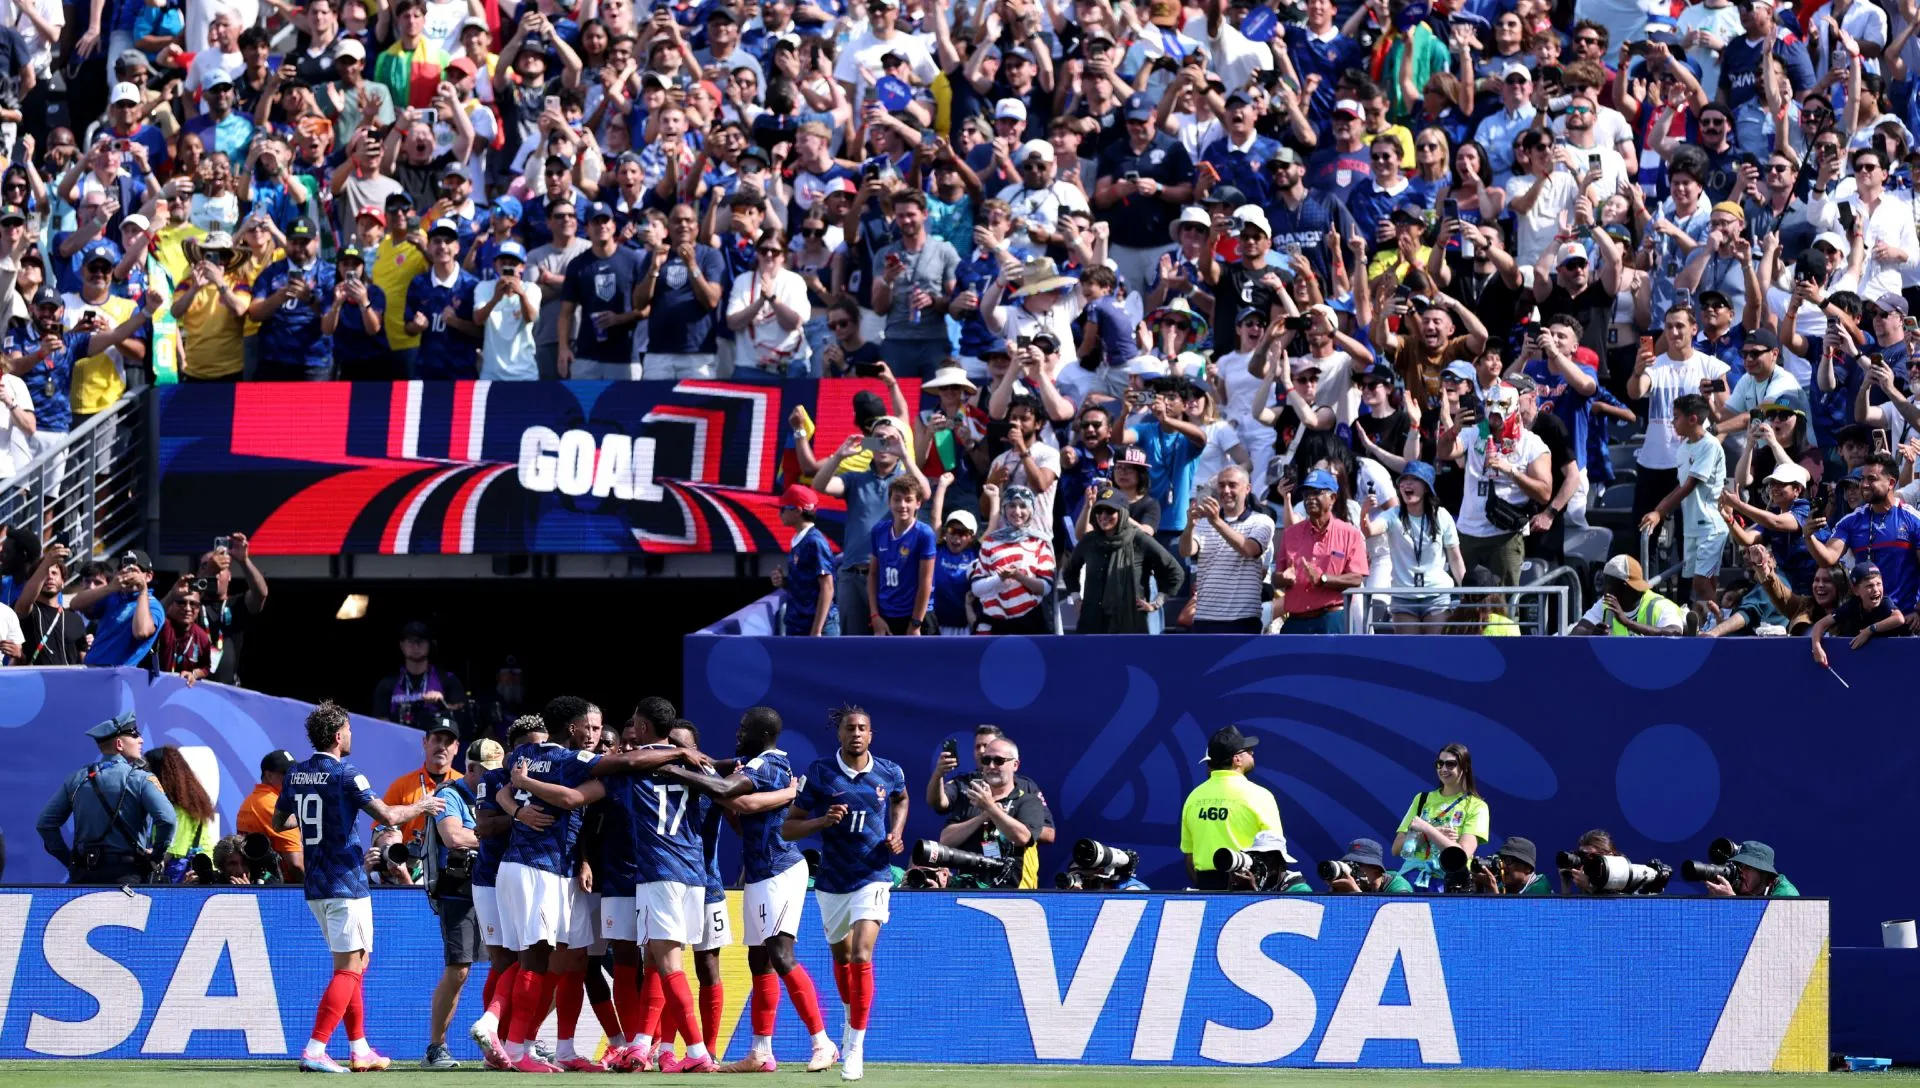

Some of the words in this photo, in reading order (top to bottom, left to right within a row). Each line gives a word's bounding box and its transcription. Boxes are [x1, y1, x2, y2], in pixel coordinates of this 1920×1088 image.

[432, 312, 447, 332] 10
[518, 425, 664, 502] GOAL
[885, 566, 899, 587] 10
[294, 794, 323, 845] 19
[653, 784, 689, 836] 17
[1198, 806, 1229, 821] 460
[850, 810, 867, 833] 11
[713, 910, 725, 932] 5
[759, 903, 768, 924] 4
[955, 896, 1463, 1065] VISA
